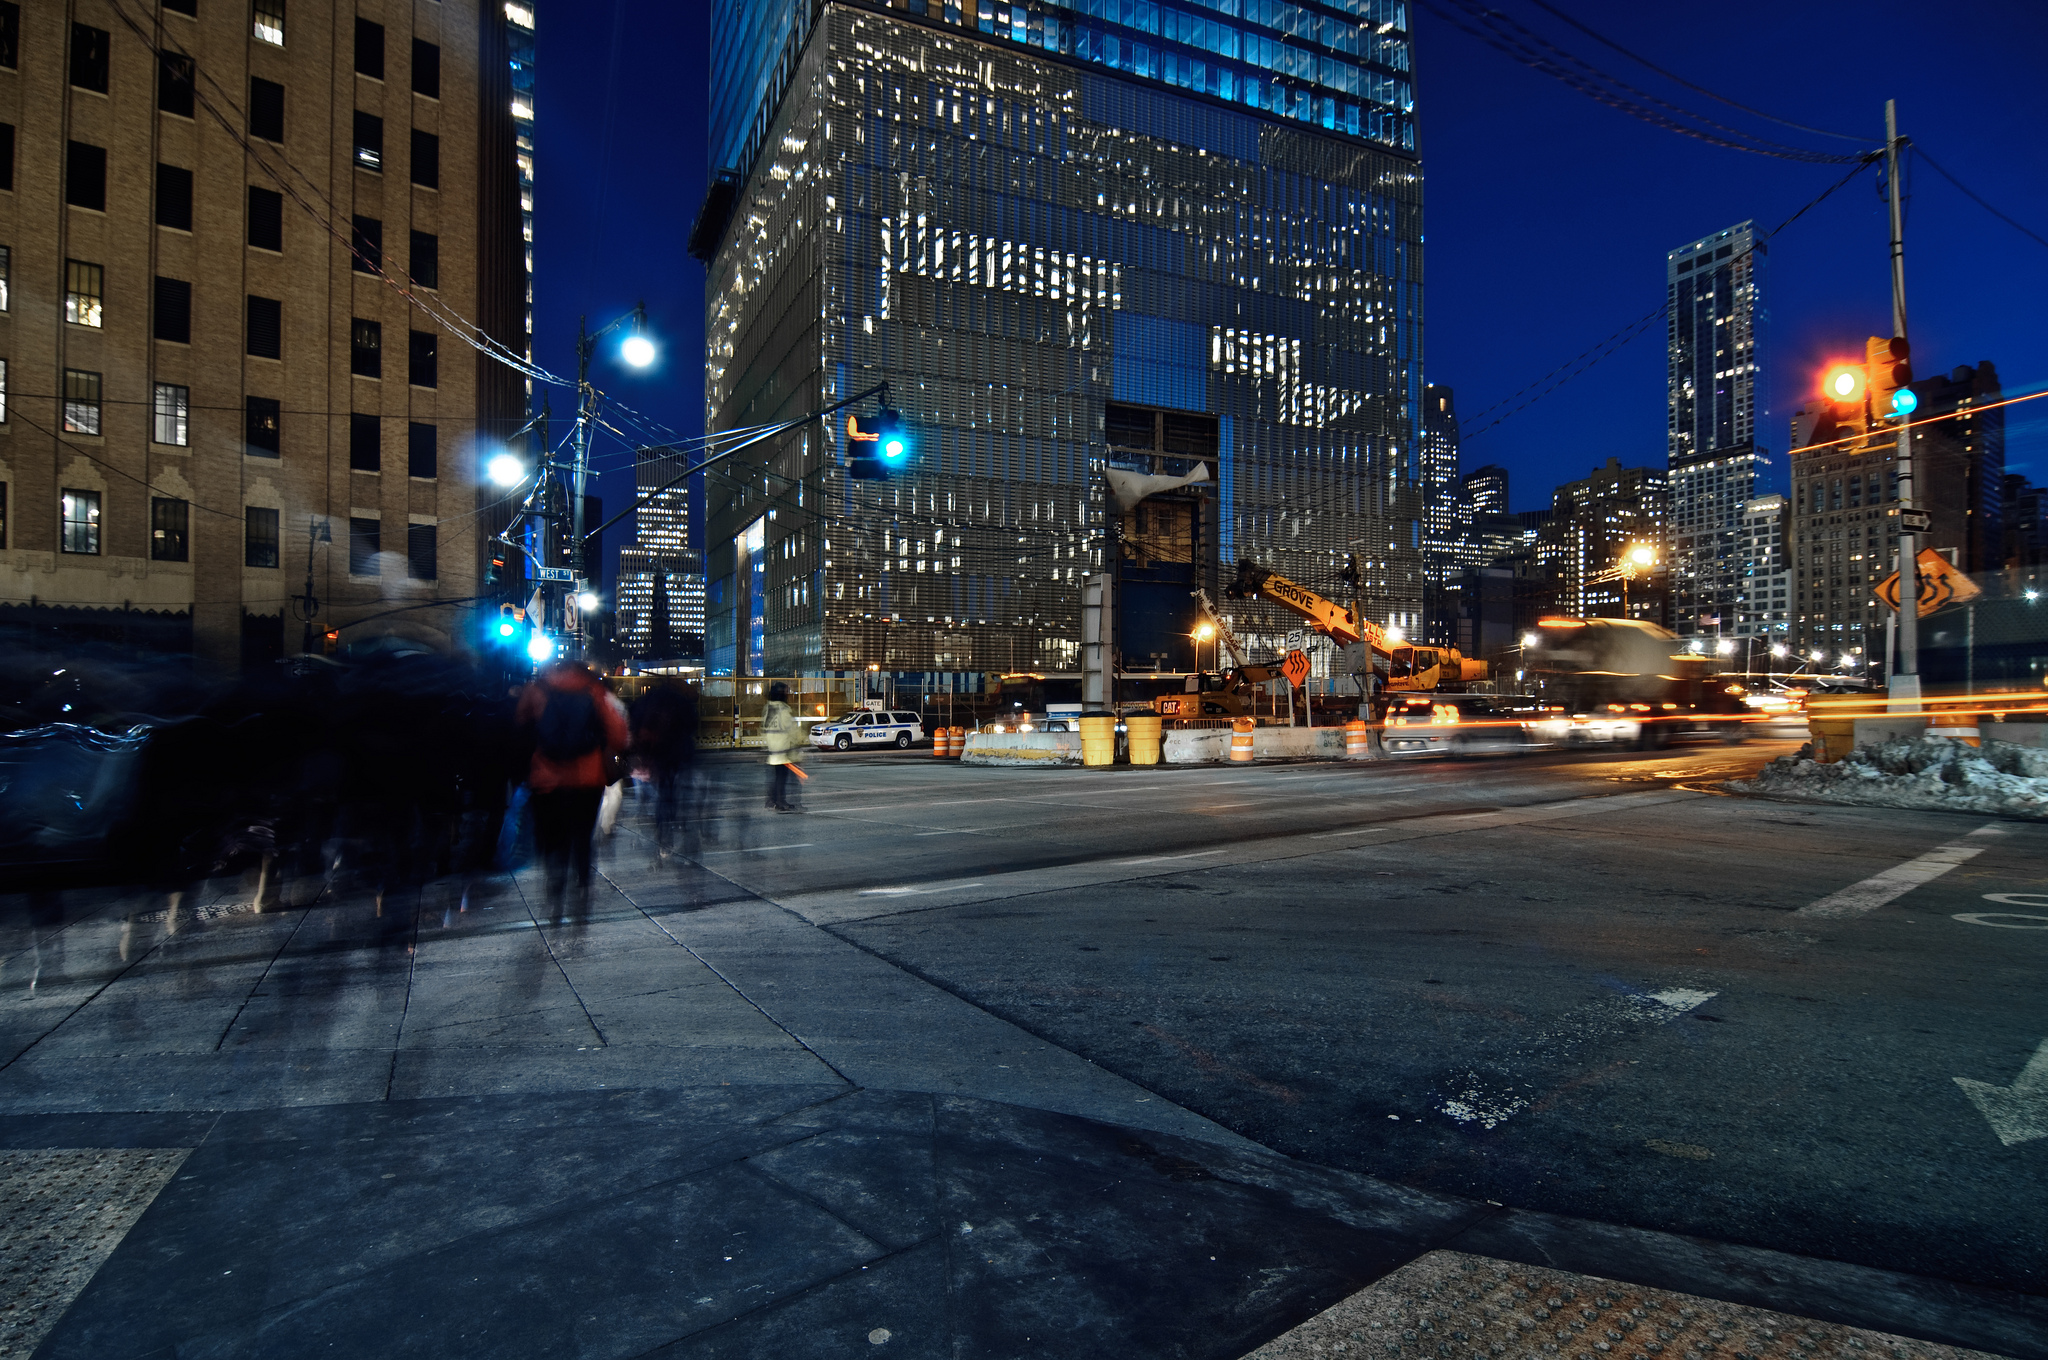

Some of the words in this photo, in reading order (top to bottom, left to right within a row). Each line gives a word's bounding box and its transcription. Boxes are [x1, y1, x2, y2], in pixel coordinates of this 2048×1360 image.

[540, 569, 559, 579] WEST
[1274, 581, 1314, 609] GROVE
[1288, 631, 1301, 643] 25
[1163, 702, 1177, 713] CAT
